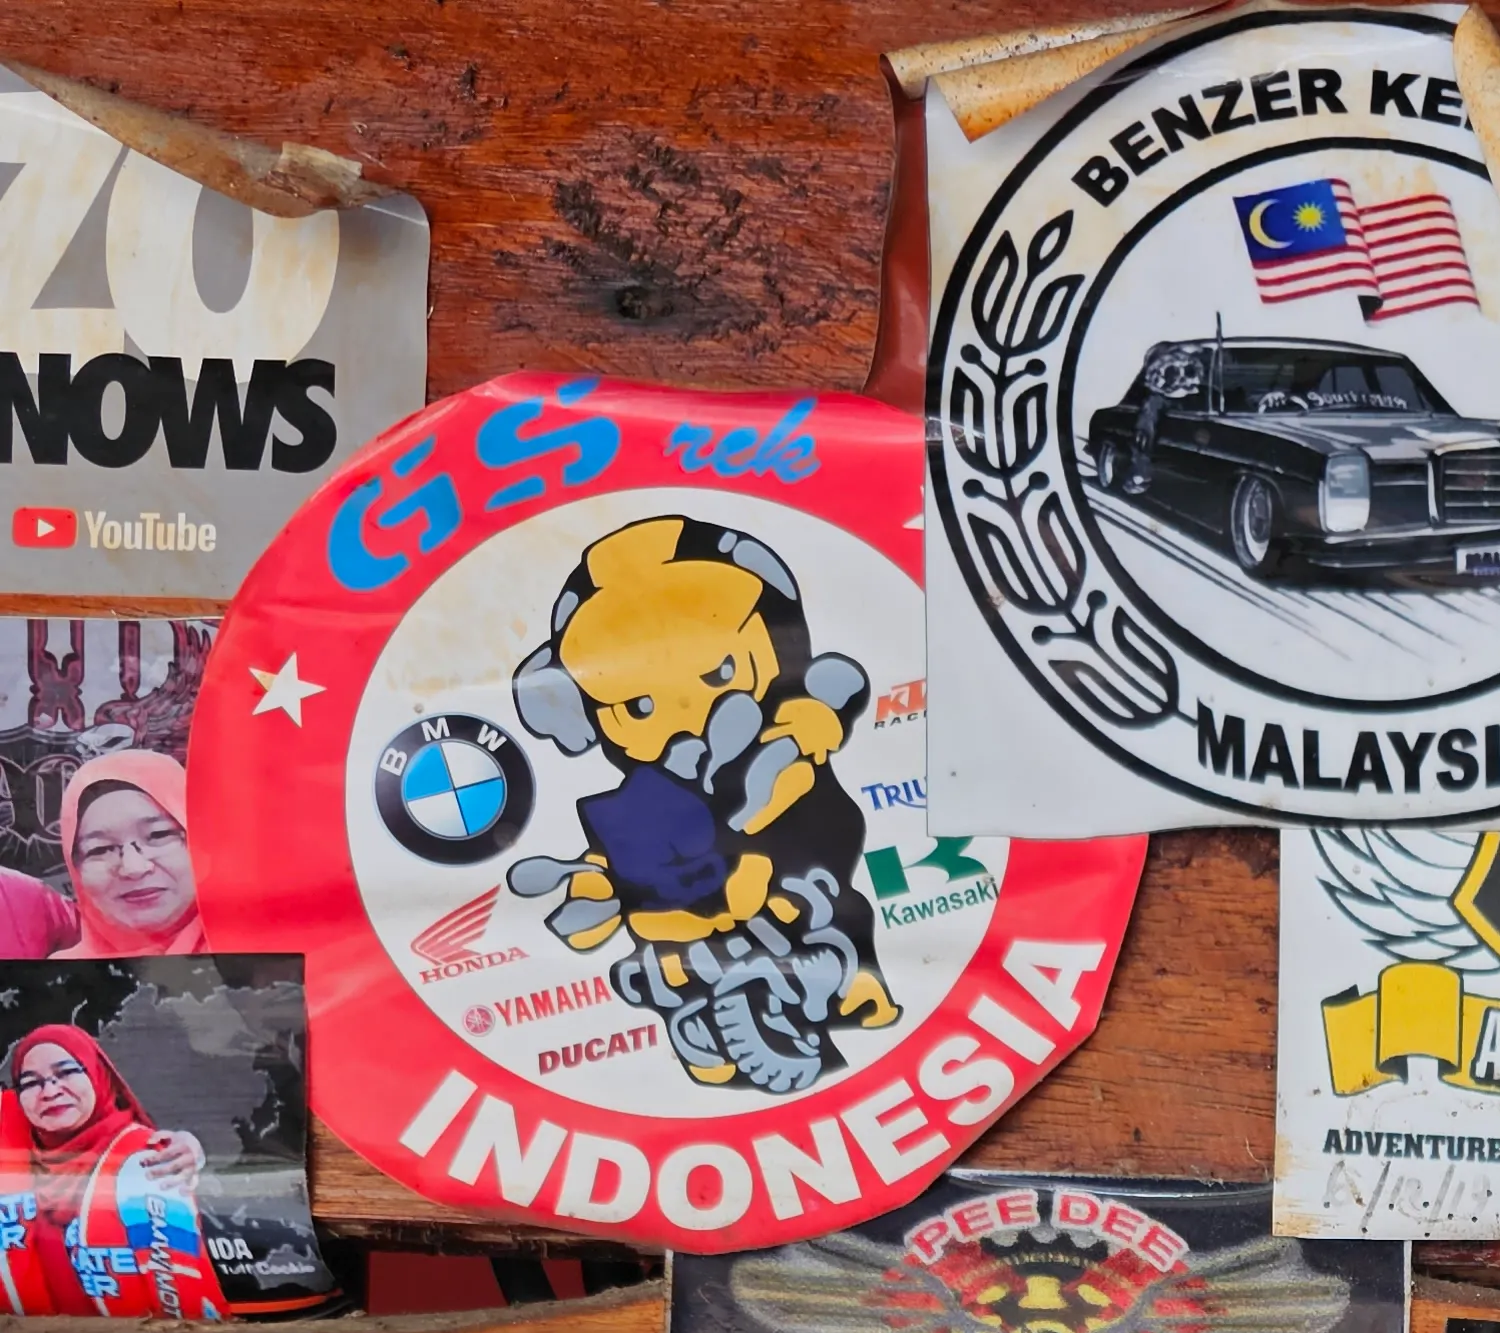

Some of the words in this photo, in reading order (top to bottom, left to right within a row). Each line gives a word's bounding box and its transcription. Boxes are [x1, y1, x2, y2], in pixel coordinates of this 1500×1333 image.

[1070, 67, 1344, 208] BENZER
[327, 377, 621, 592] GS
[84, 511, 217, 552] YouTube
[880, 877, 1001, 931] Kawasaki
[419, 945, 530, 986] HONDA
[494, 976, 613, 1028] YAMAHA
[537, 1024, 658, 1075] DUCATI
[399, 939, 1108, 1232] INDONESIA
[911, 1193, 1038, 1263] PEE
[1059, 1193, 1187, 1268] DEE
